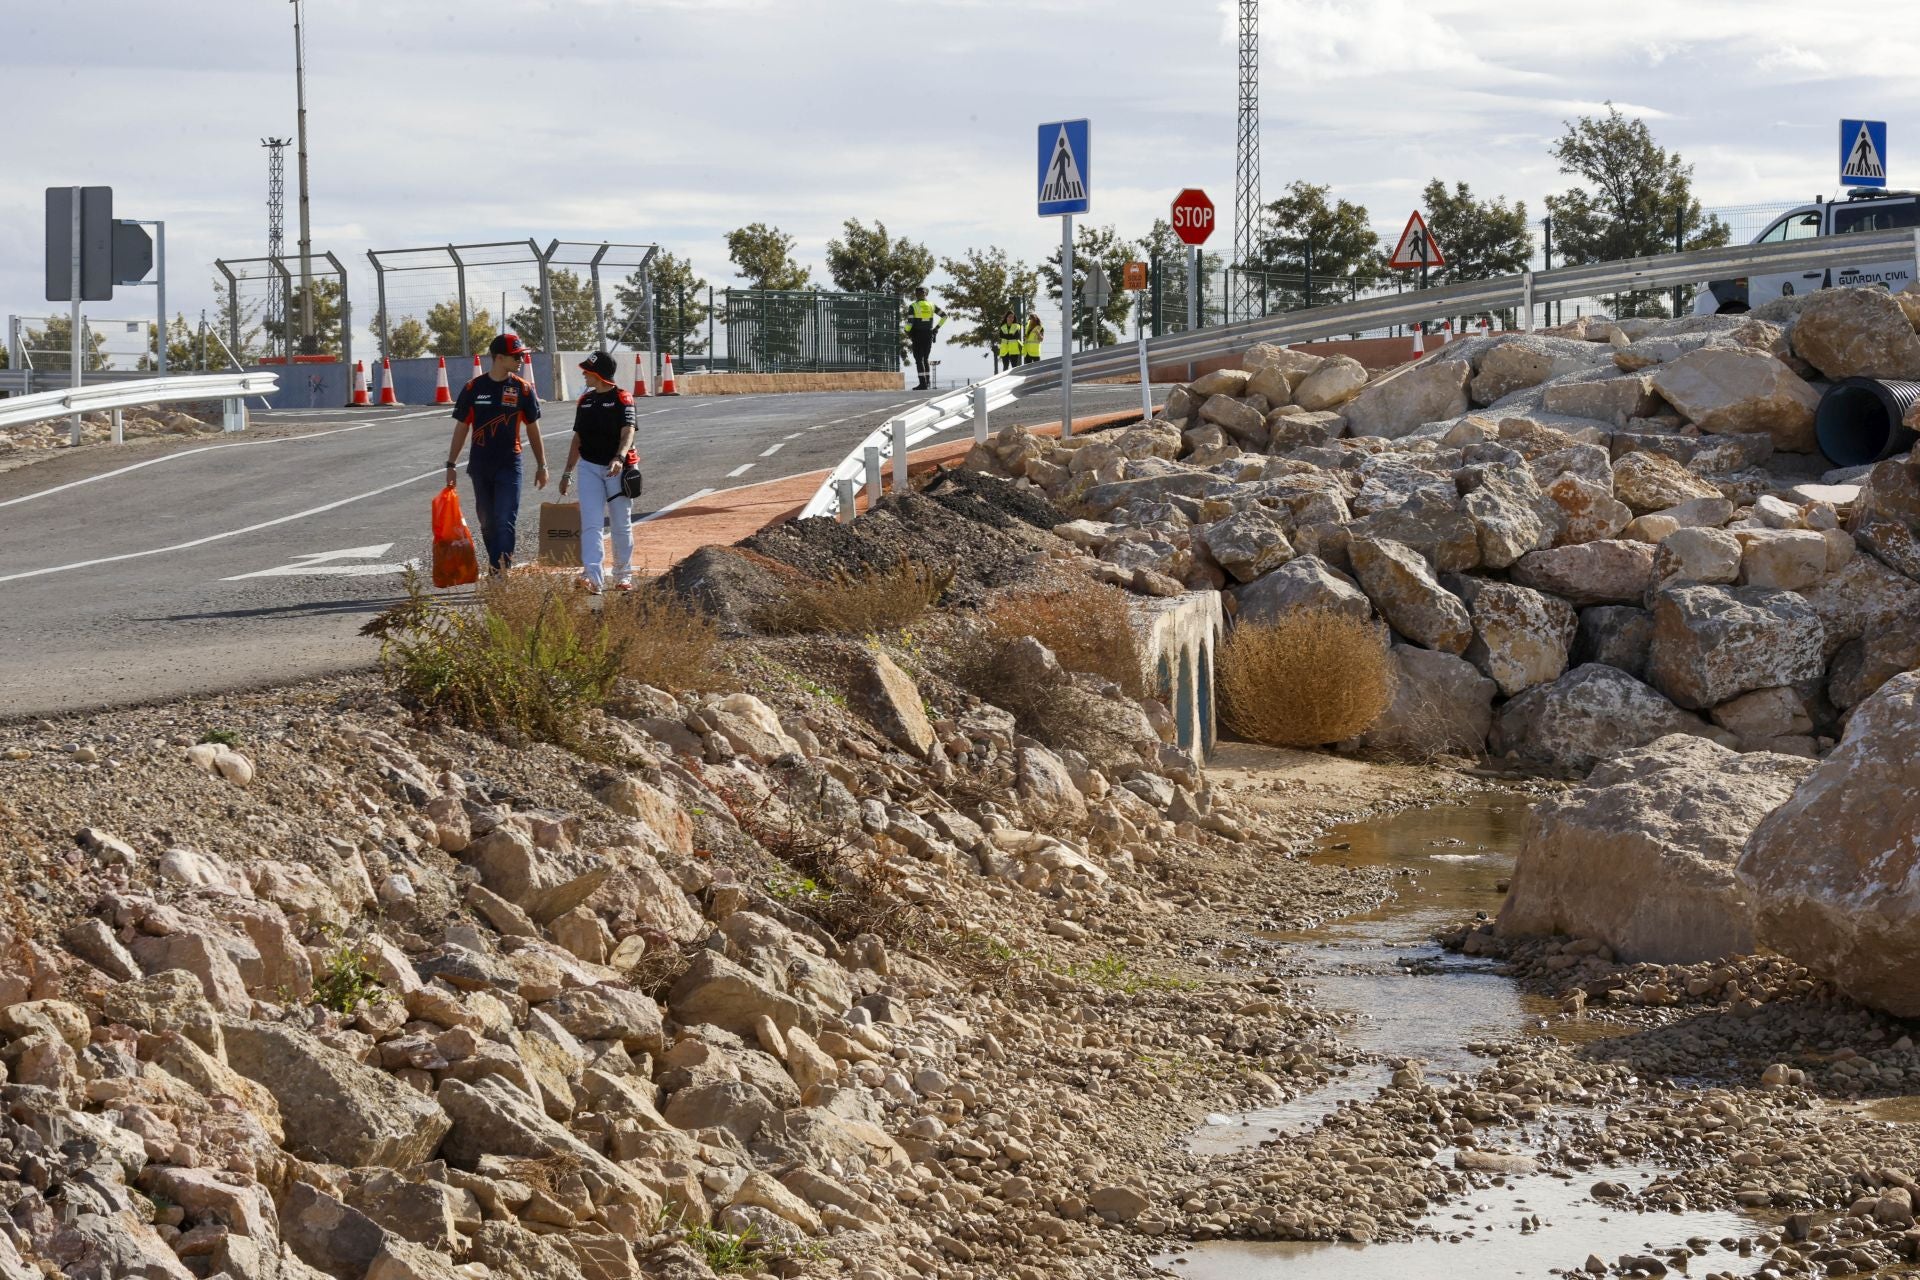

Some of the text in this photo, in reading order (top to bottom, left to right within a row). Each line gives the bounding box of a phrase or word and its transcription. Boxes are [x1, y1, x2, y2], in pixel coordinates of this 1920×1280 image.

[1174, 206, 1213, 228] STOP
[1838, 271, 1909, 285] GUARDIA CIVIL
[547, 529, 580, 538] SBK
